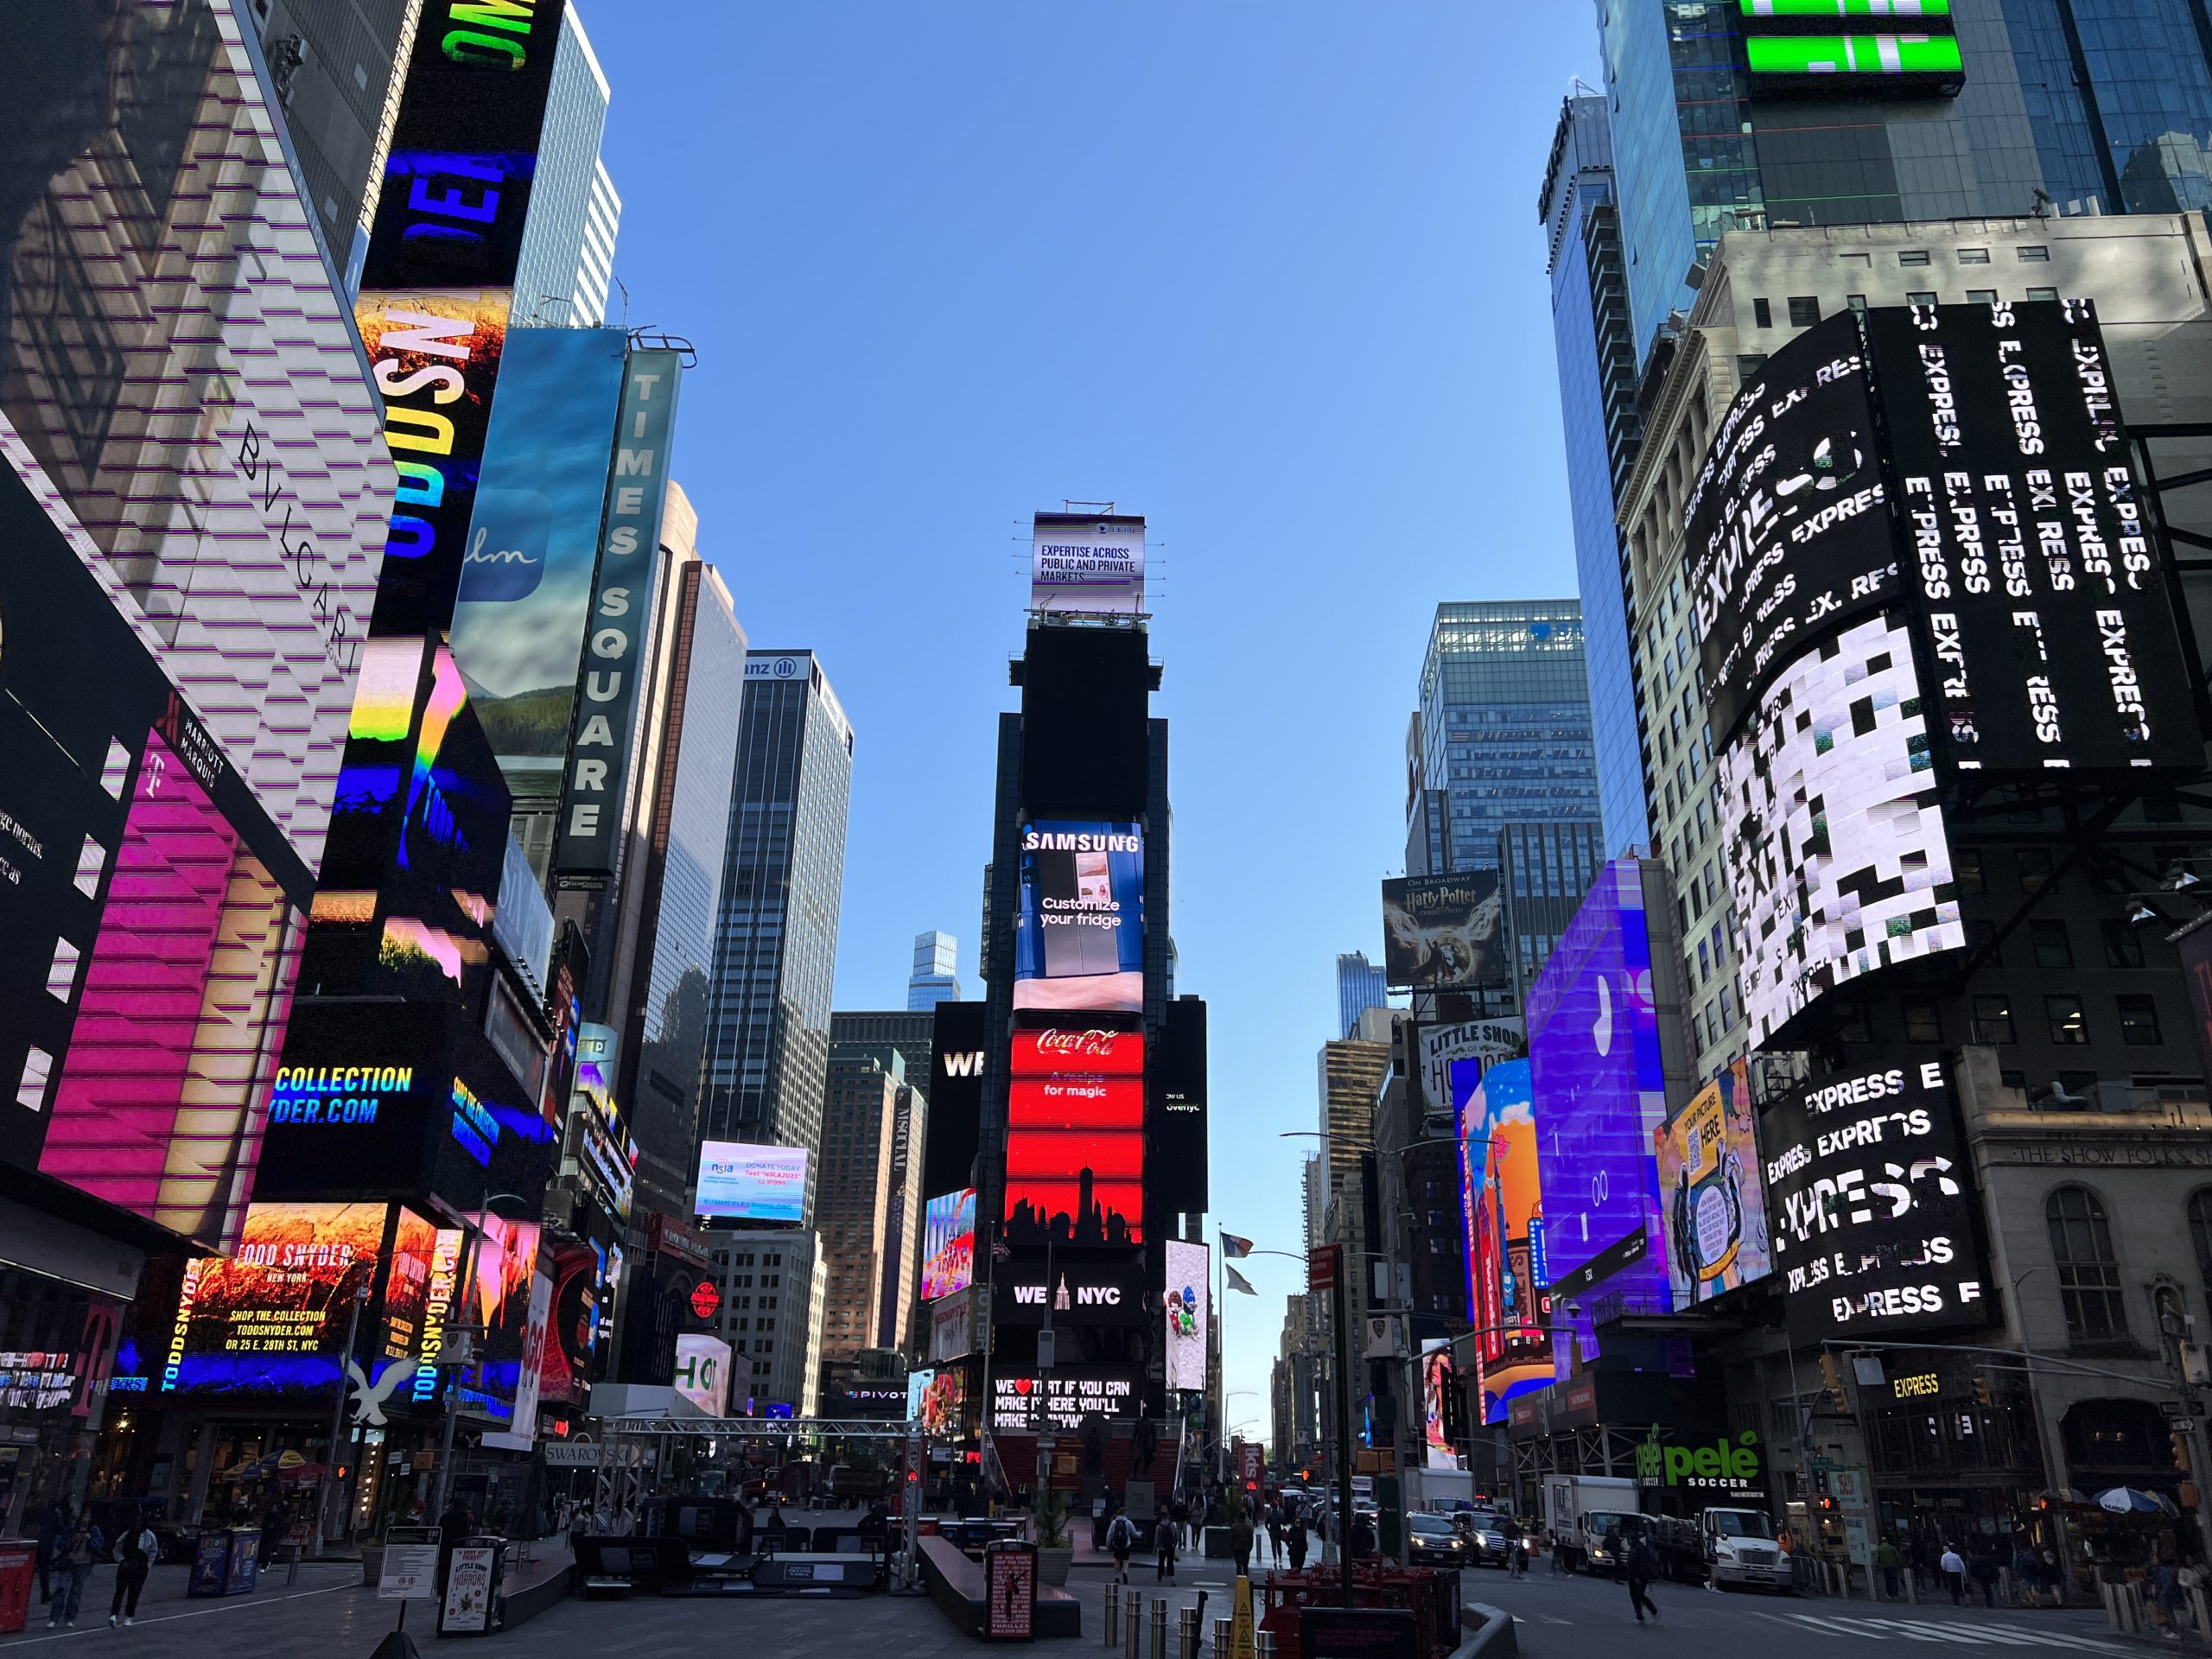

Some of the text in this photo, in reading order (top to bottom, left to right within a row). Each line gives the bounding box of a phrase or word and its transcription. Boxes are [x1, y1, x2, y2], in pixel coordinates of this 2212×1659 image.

[238, 418, 357, 677] BVLGARI
[1041, 545, 1129, 559] EXPERTISE ACROSS
[1041, 558, 1135, 572] PUBLIC AND PRIVATE
[1040, 571, 1085, 582] MARKETS
[569, 374, 660, 836] TIMES SQUARE
[184, 718, 225, 774] MARRIOTT
[180, 740, 216, 791] MARQUIS
[1027, 832, 1139, 853] SAMSUNG
[1408, 876, 1472, 887] ON BROADWAY
[1042, 898, 1120, 911] Customize
[1406, 886, 1478, 913] Harry Potter
[1040, 913, 1122, 930] your fridge
[1430, 1025, 1480, 1057] LITTLE
[276, 1067, 412, 1091] COLLECTION
[1920, 1062, 1944, 1089] E
[1044, 1085, 1106, 1098] for magic
[1685, 1091, 1718, 1133] YOUR PICTURE
[1700, 1114, 1721, 1148] HERE
[2015, 1147, 2054, 1162] THE
[2062, 1147, 2116, 1163] SHOW
[2126, 1147, 2188, 1164] FOLKS
[712, 1163, 734, 1174] nsla
[747, 1162, 775, 1171] DONATE
[703, 1198, 792, 1211] SUMMERLEARNING.ORG
[283, 1245, 352, 1267] SNYDER
[267, 1274, 307, 1282] NEW YORK
[1585, 1268, 1593, 1282] TSX
[1014, 1286, 1121, 1305] WE NYC
[257, 1311, 271, 1321] THE
[274, 1312, 326, 1322] COLLECTION
[237, 1325, 314, 1336] TODDSNYDER.COM
[226, 1341, 238, 1350] OR
[240, 1340, 251, 1350] 25
[252, 1341, 261, 1350] E.
[264, 1341, 284, 1350] 28TH
[302, 1341, 319, 1351] NYC
[995, 1379, 1015, 1394] WE
[1065, 1381, 1077, 1395] IF
[1079, 1381, 1102, 1395] YOU
[1105, 1382, 1129, 1395] CAN
[1895, 1374, 1939, 1399] EXPRESS
[995, 1396, 1027, 1411] MAKE
[1079, 1397, 1120, 1413] YOU'LL
[995, 1413, 1027, 1427] MAKE
[1636, 1422, 1662, 1477] pelé
[1663, 1428, 1759, 1486] pelé
[1244, 1444, 1256, 1478] tkts
[1643, 1478, 1659, 1486] SOCCER
[1688, 1478, 1748, 1488] SOCCER
[456, 1563, 487, 1573] LITTLE SHOP
[454, 1573, 486, 1588] HORRORS
